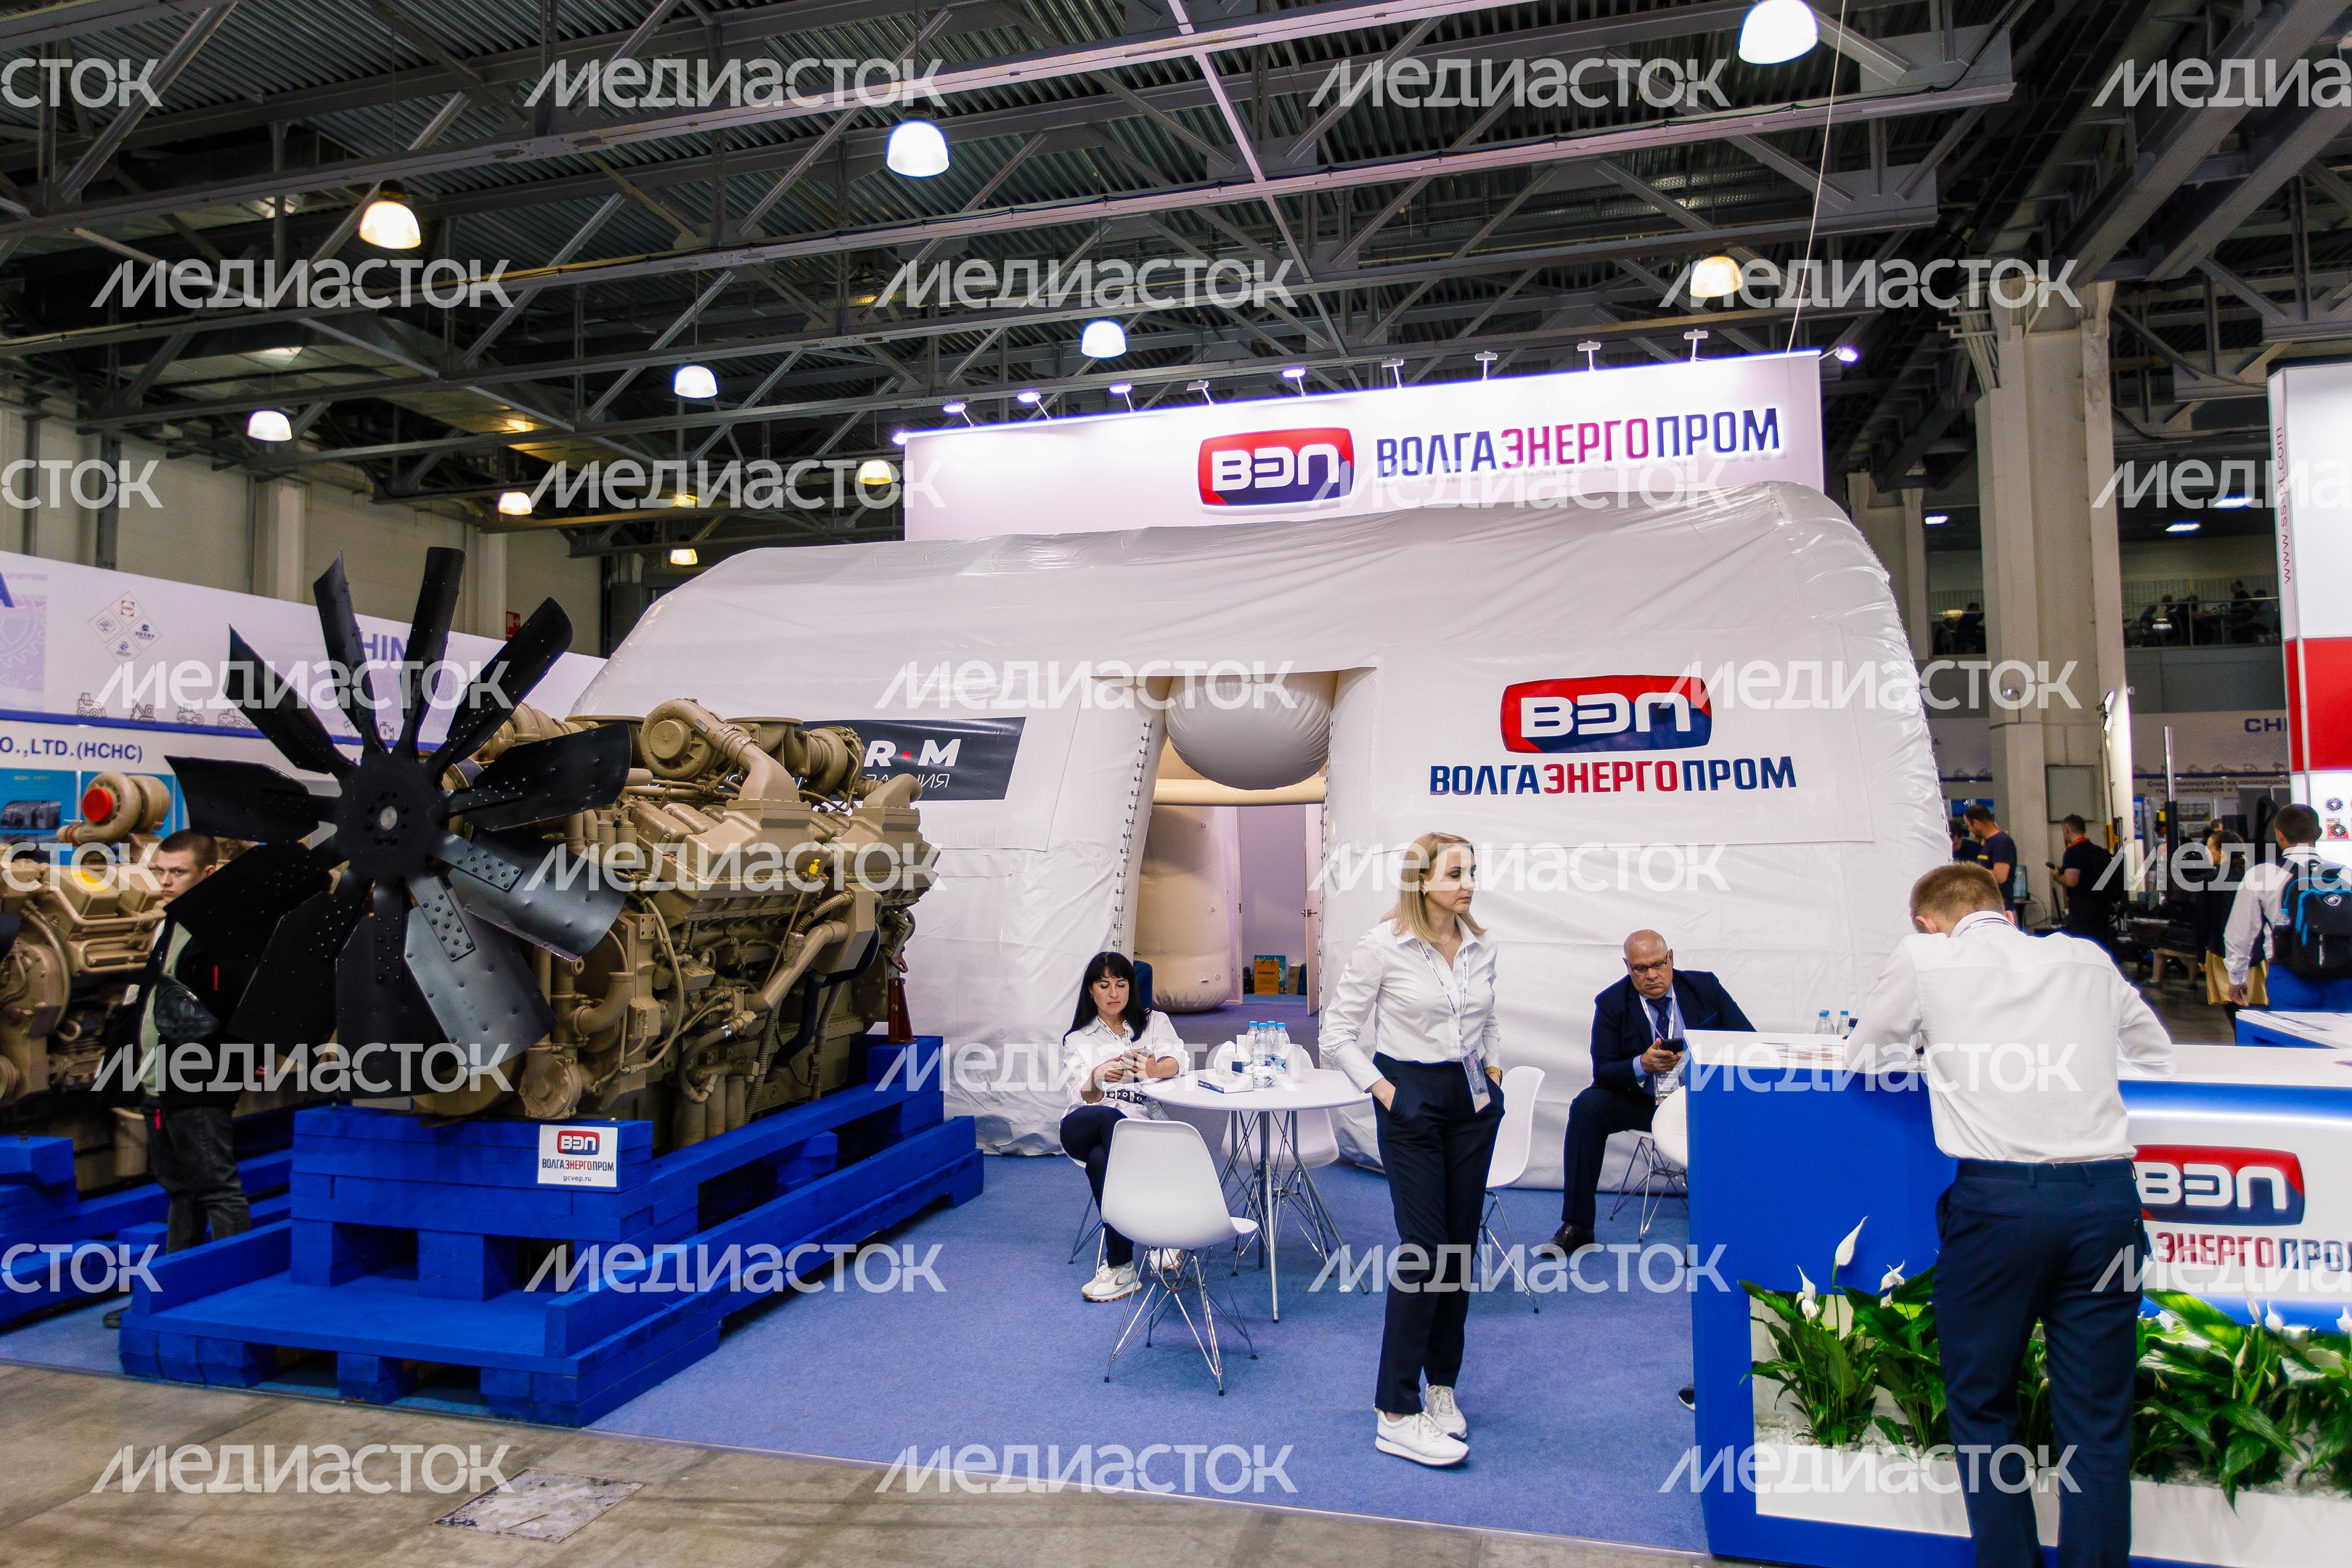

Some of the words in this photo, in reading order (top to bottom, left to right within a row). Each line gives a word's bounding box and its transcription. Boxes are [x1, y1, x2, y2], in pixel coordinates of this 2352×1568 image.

[1376, 407, 1781, 479] ВОЛГАЭНЕРГОПРОМ
[1429, 755, 1797, 796] ВОЛГАЭНЕРГОПРОМ
[542, 1158, 615, 1172] ВОЛГАЭНЕРГОПРОМ
